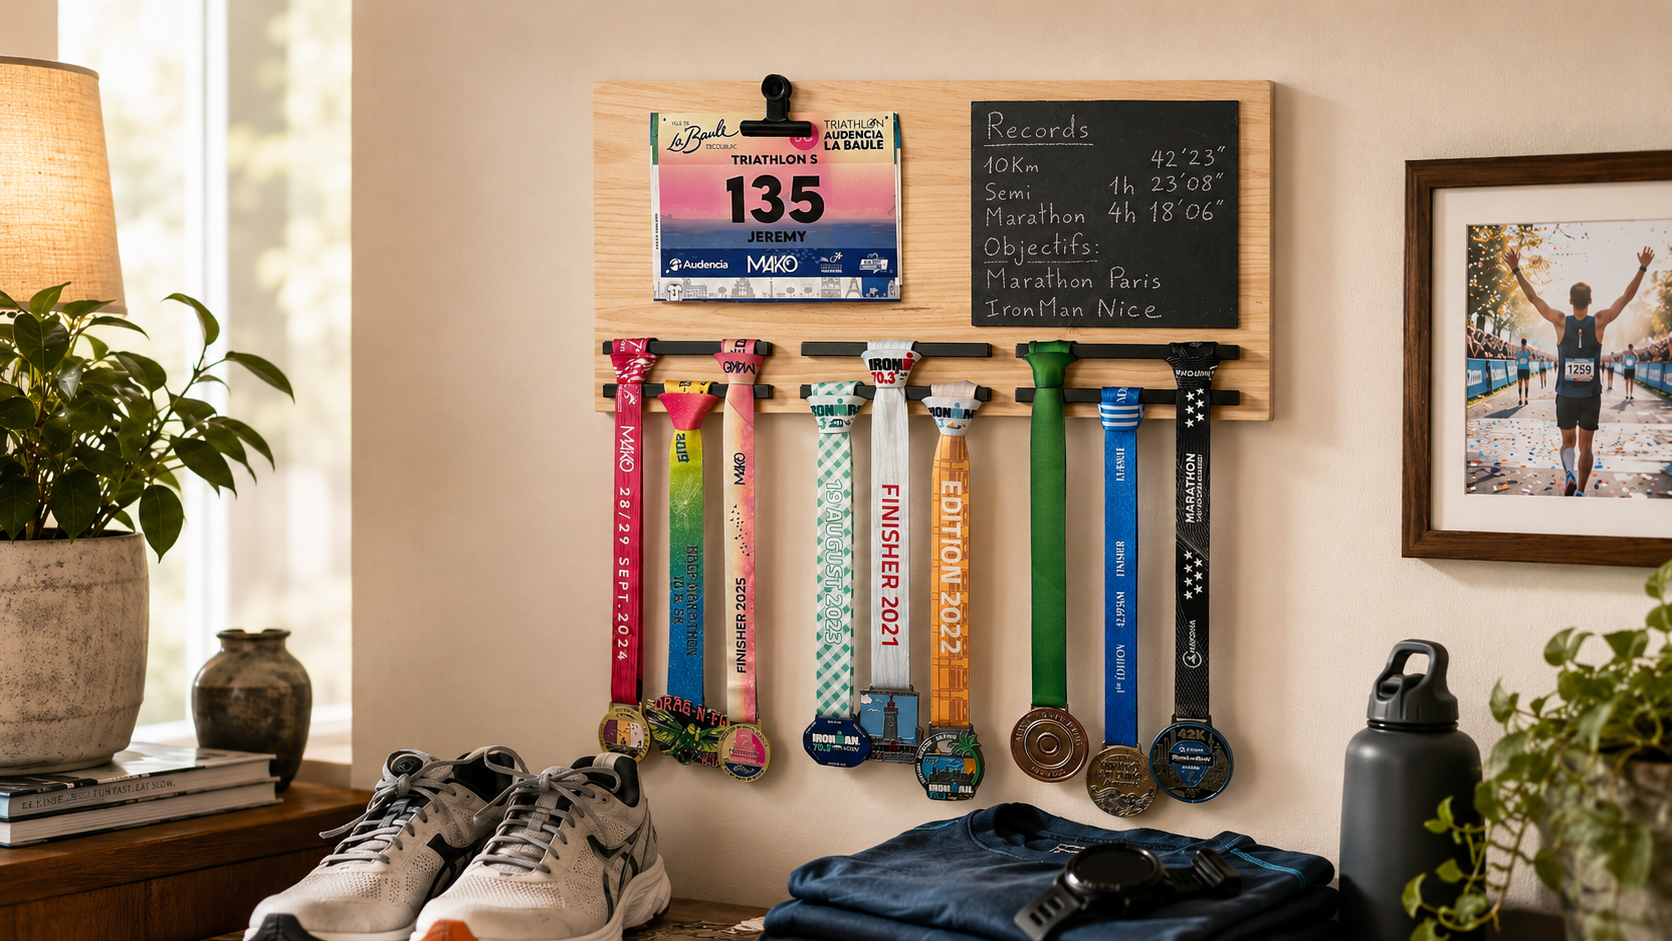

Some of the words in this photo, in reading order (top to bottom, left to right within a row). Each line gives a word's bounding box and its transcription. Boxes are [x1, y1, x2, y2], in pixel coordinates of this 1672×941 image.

[824, 118, 884, 129] TRIATHLON
[824, 130, 884, 140] AUDENCIA
[987, 111, 1089, 140] Records
[731, 154, 806, 165] TRIATHLON
[810, 153, 818, 164] S
[824, 140, 841, 151] LA
[844, 139, 884, 150] BAULE
[726, 174, 825, 224] 135
[985, 182, 1031, 201] Semi
[1108, 175, 1135, 195] 1h
[986, 202, 1085, 227] Marathon
[1108, 201, 1136, 223] 4h
[747, 231, 808, 243] JEREMY
[984, 232, 1099, 266] Objectifs:
[682, 259, 729, 270] Audencia
[747, 255, 799, 274] MAKO
[987, 267, 1093, 289] Marathon
[1110, 266, 1161, 289] Paris
[1097, 298, 1162, 319] Nice
[871, 371, 896, 385] 70.3
[1567, 363, 1592, 376] 1259
[619, 425, 635, 473] MAKO
[675, 433, 690, 463] 2019
[733, 452, 746, 485] MAKO
[1185, 452, 1196, 523] MARATHON
[618, 487, 631, 545] 28/29
[881, 484, 900, 589] FINISHER
[940, 480, 962, 584] EDITION
[825, 507, 843, 590] AUGUST
[735, 577, 746, 611] 2025
[825, 594, 843, 645] 2023
[881, 596, 899, 647] 2021
[940, 591, 961, 654] 2022
[736, 613, 746, 673] FINISHER
[1177, 728, 1207, 741] 42K
